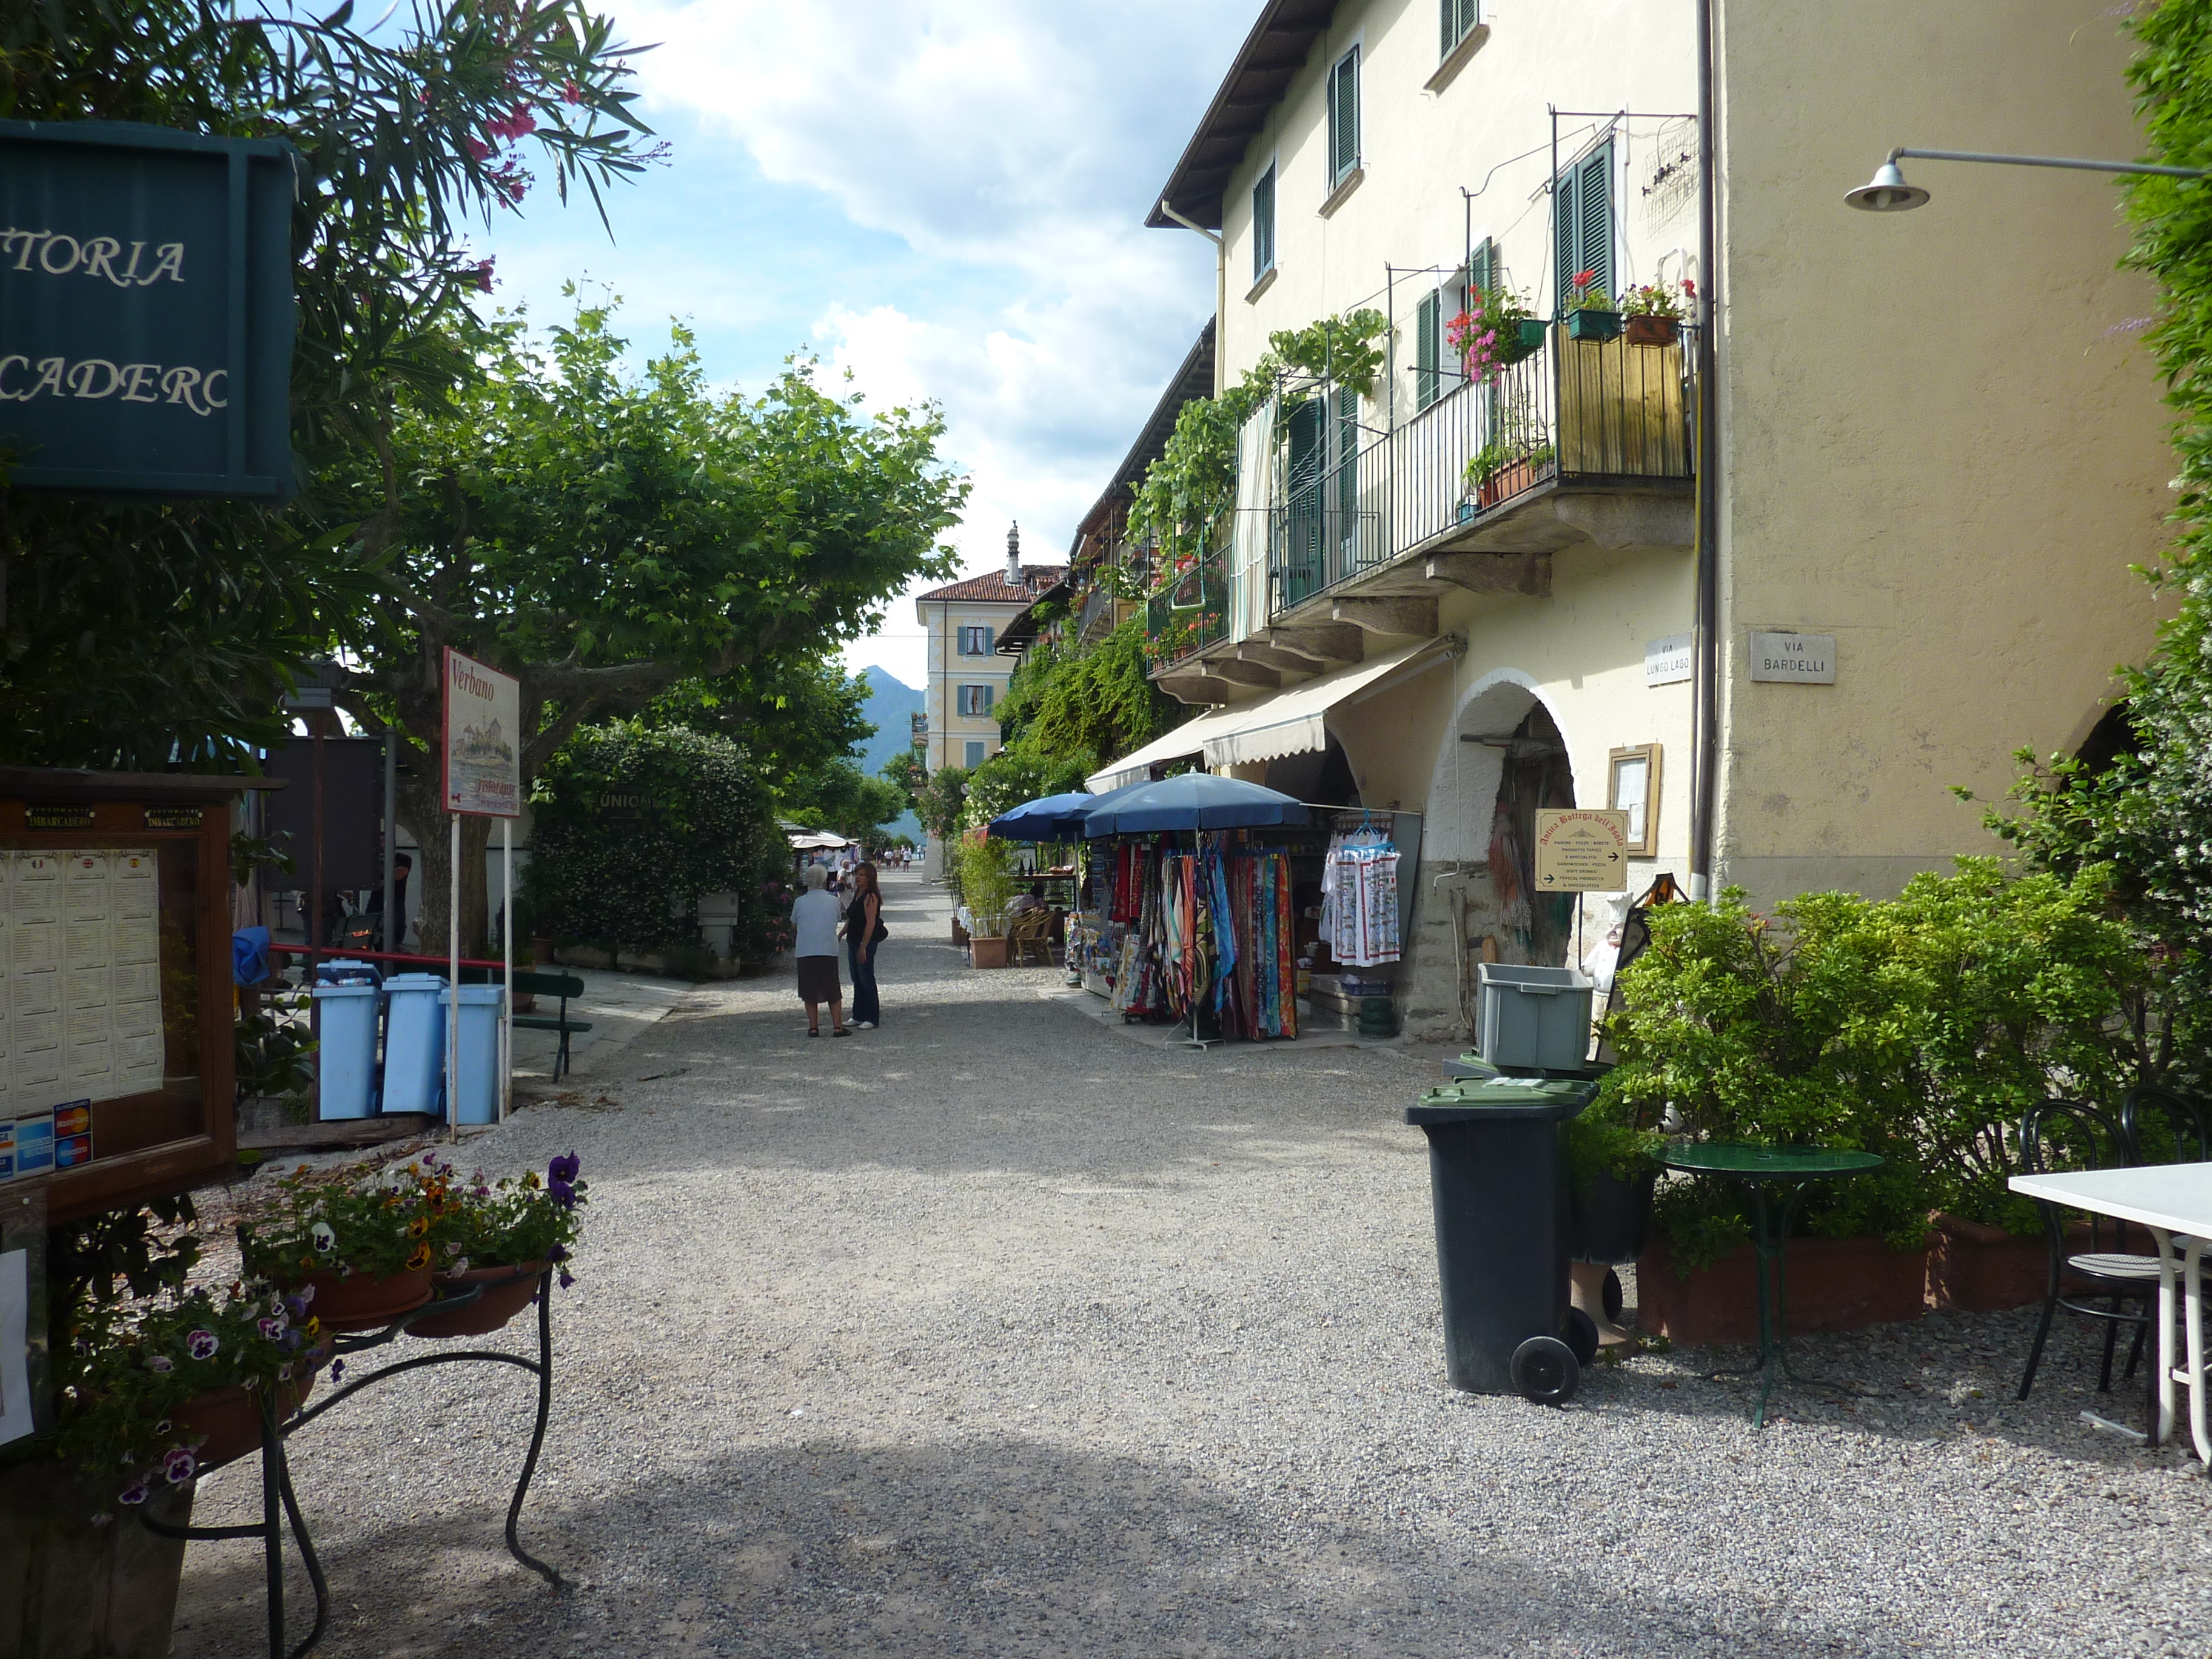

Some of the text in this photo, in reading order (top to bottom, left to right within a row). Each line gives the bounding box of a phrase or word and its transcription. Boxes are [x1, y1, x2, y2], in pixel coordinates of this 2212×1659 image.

[0, 226, 184, 287] TORIA
[1662, 644, 1673, 654] VIA
[1785, 642, 1803, 652] VIA
[1646, 657, 1689, 675] LUNGO LAGO
[1764, 659, 1824, 672] BARDELLI
[452, 658, 494, 702] Verbano
[1540, 823, 1560, 846] Antica
[1558, 813, 1592, 825] Bottega
